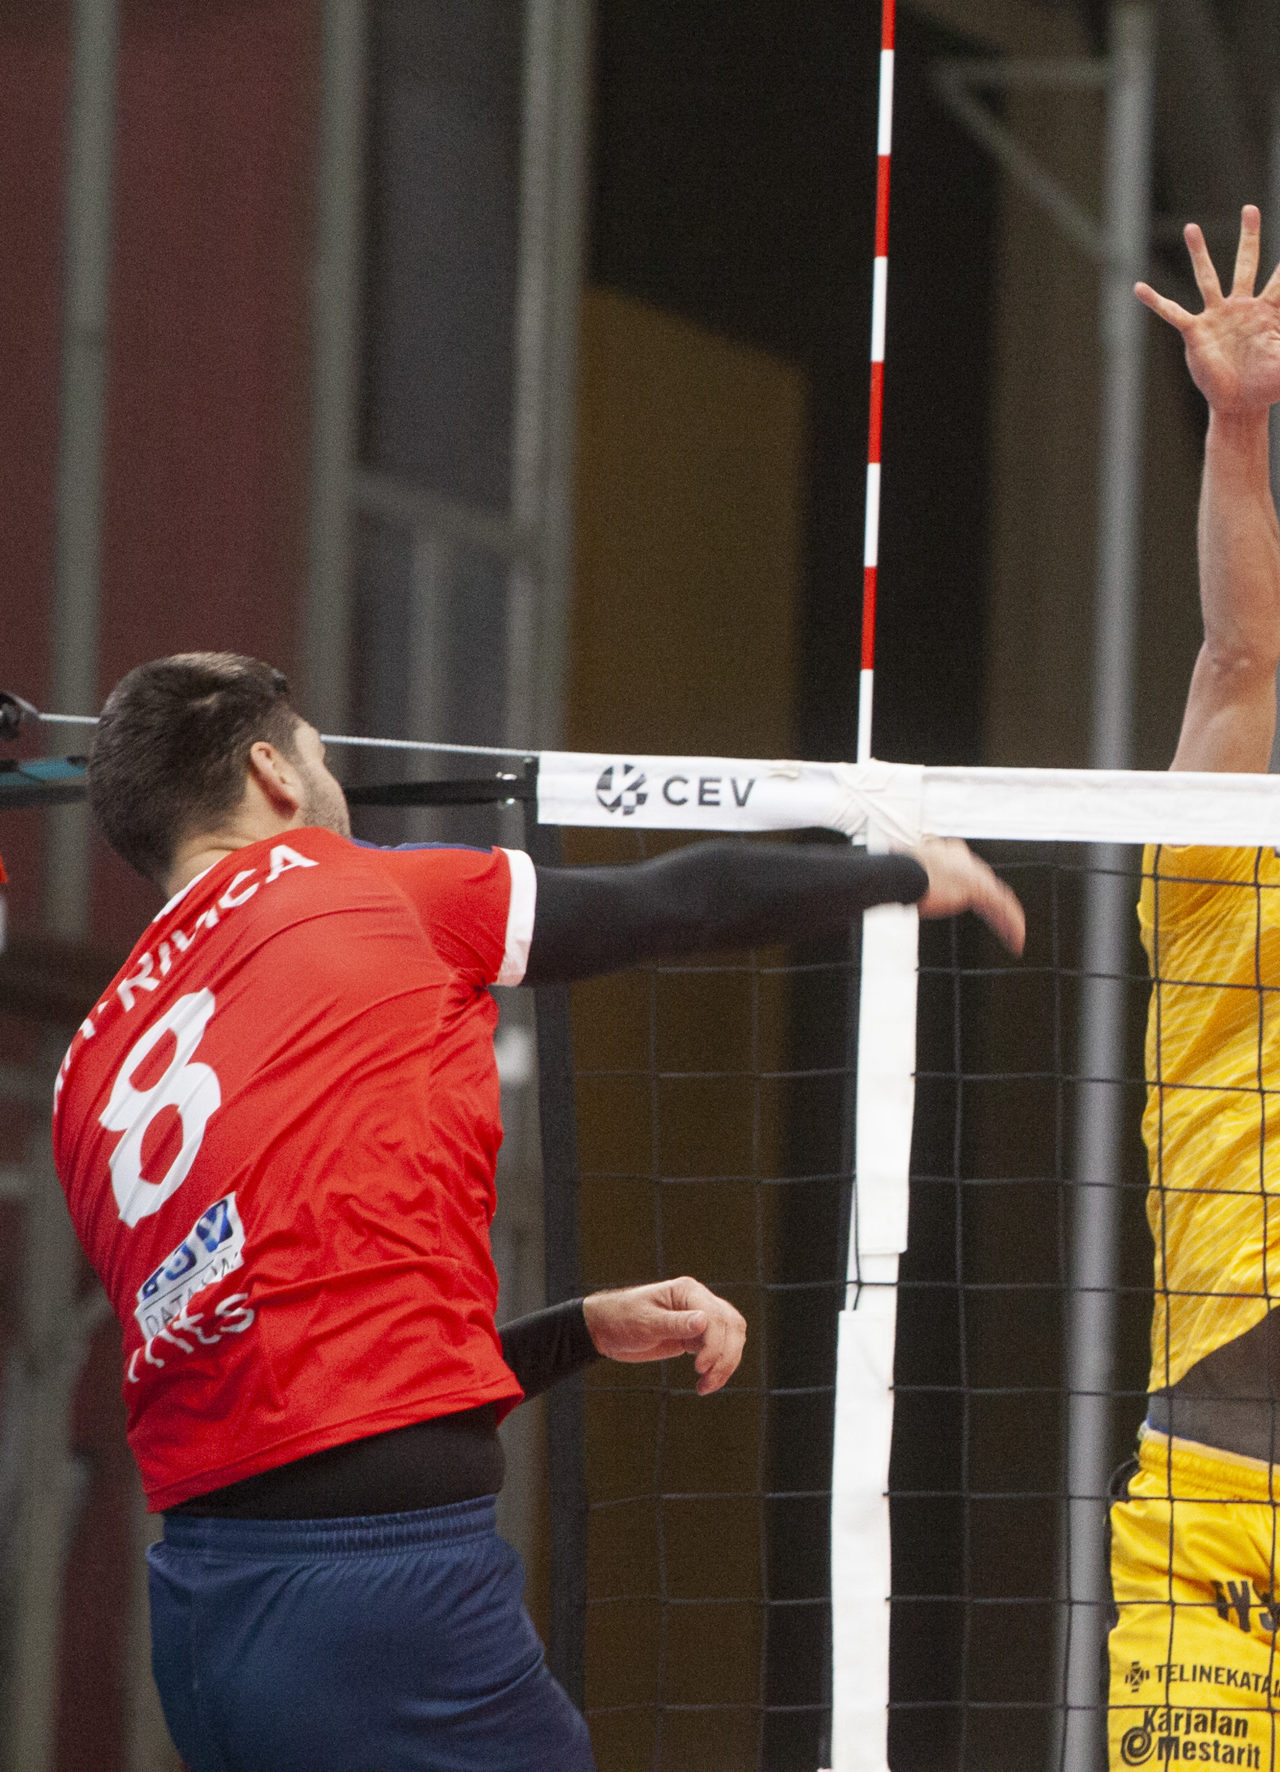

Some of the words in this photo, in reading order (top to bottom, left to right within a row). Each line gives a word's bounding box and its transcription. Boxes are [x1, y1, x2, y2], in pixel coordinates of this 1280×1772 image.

[662, 776, 755, 807] CEV
[98, 986, 222, 1229] 8
[1143, 1706, 1249, 1739] Karjalan
[1157, 1736, 1261, 1770] Mestarit
